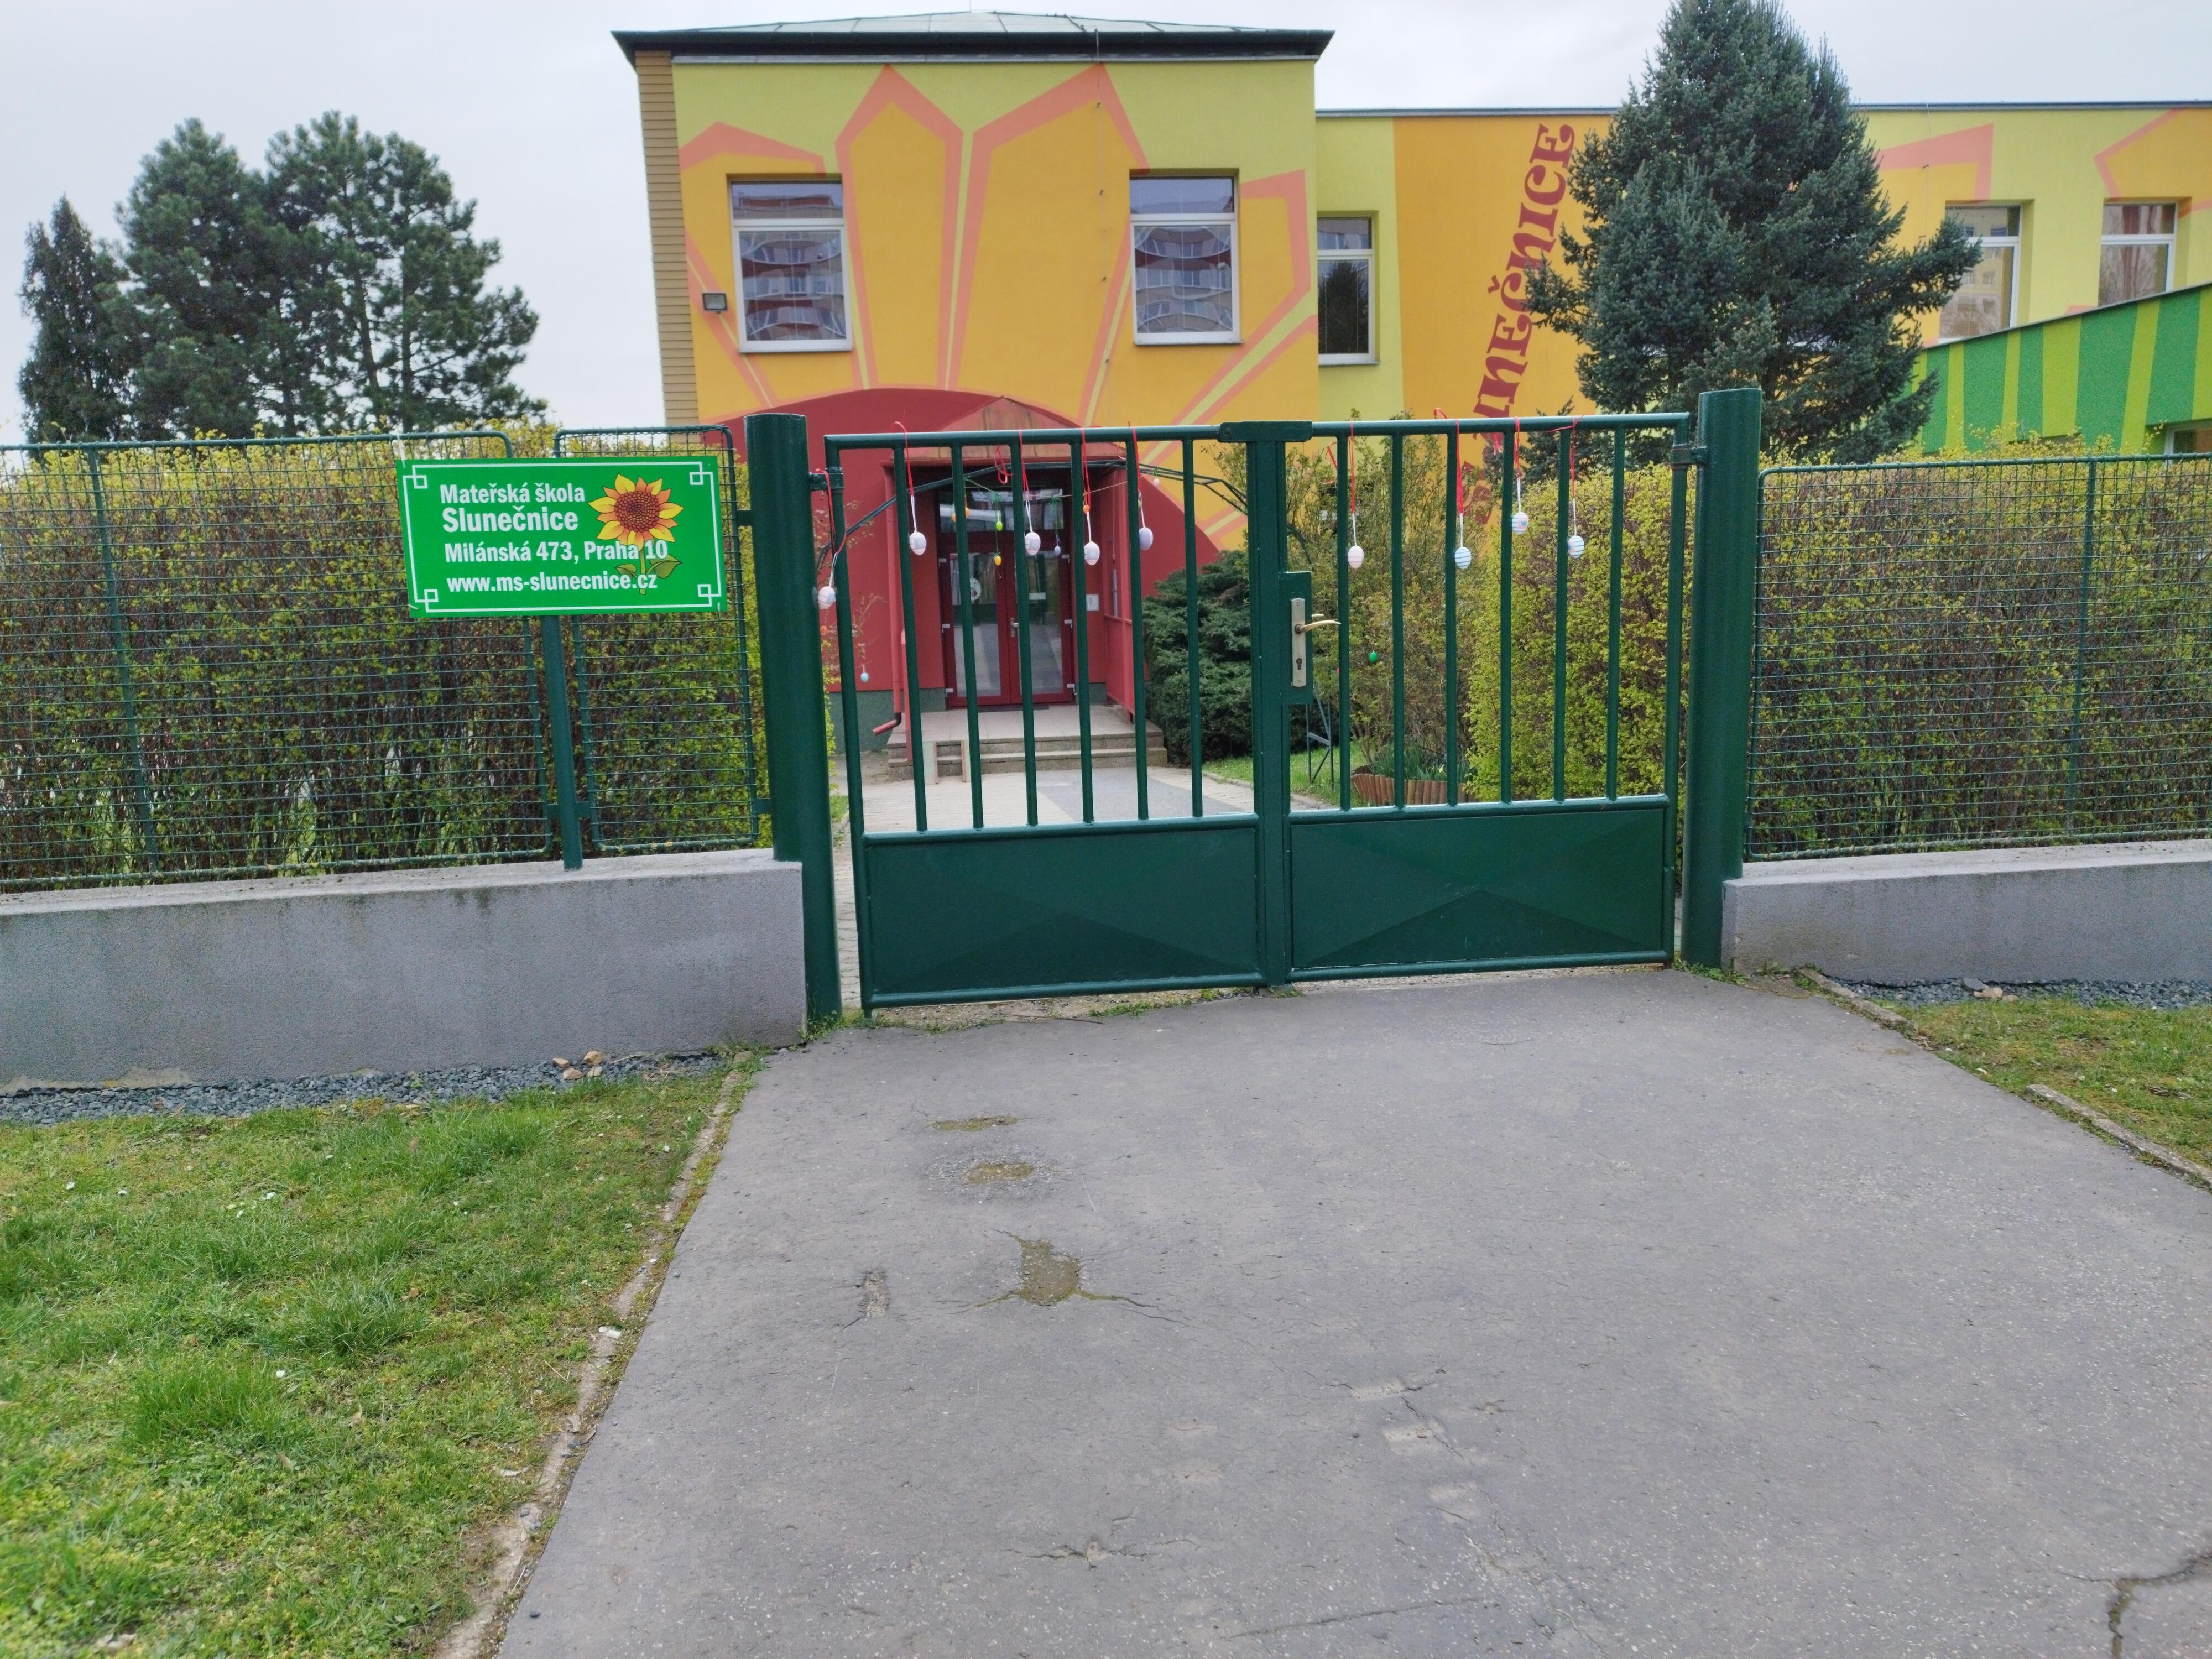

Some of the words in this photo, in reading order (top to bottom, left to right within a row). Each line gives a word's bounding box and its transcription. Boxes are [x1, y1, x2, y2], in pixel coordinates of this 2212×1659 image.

[440, 483, 530, 504] Mateřská
[535, 483, 585, 503] škola
[442, 505, 578, 533] Slunečnice
[445, 541, 531, 562] Milánská
[536, 541, 579, 564] 473,
[584, 540, 639, 560] Praha
[644, 539, 668, 559] 10
[446, 571, 658, 592] www.ms-slunecnice.cz
